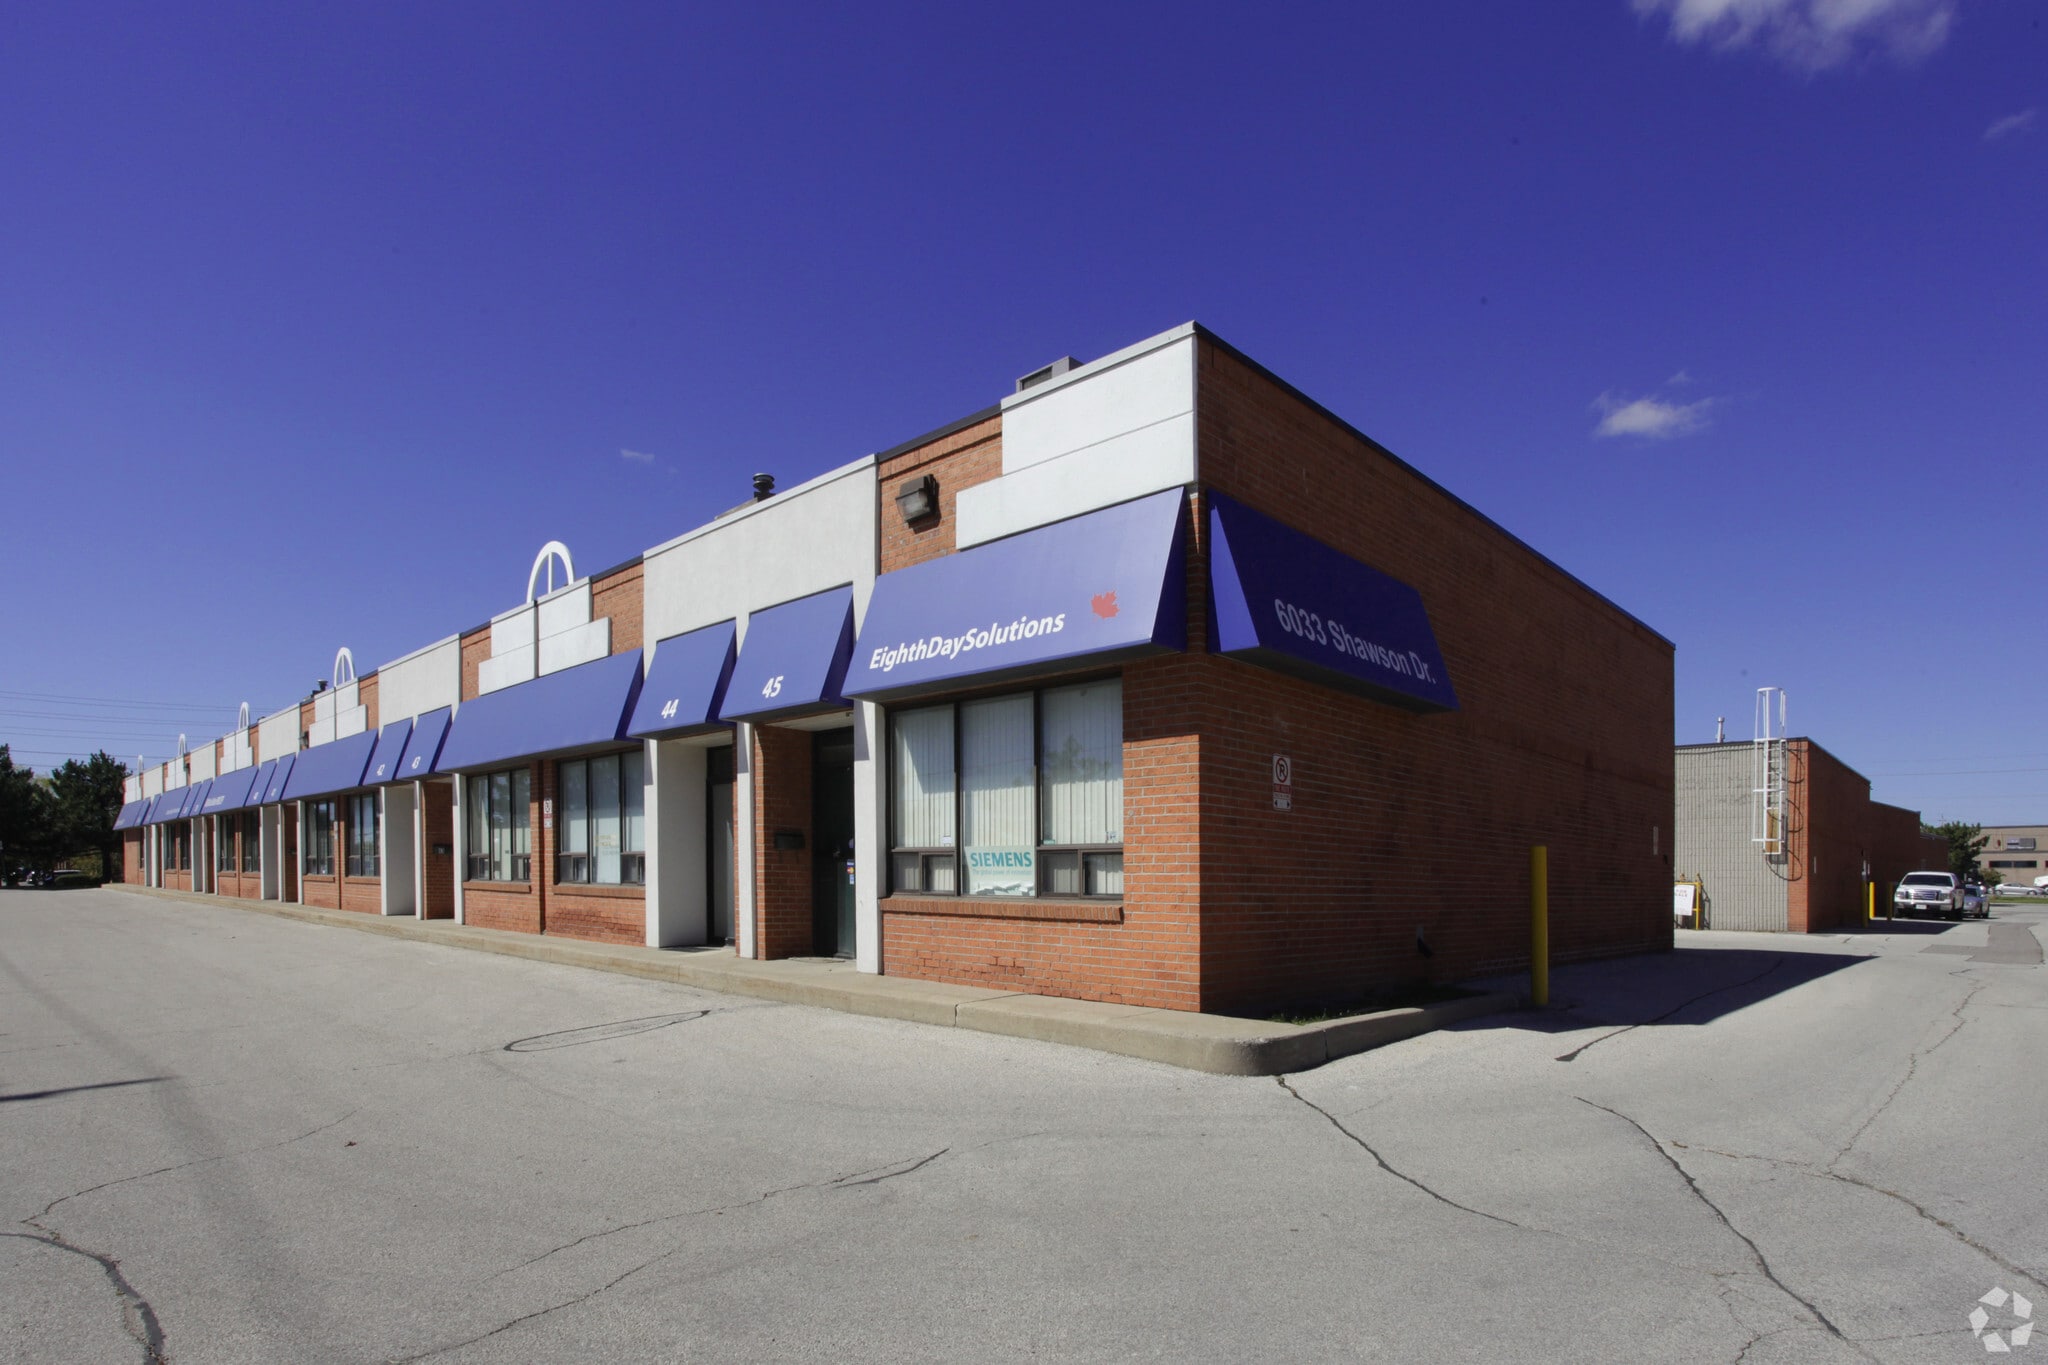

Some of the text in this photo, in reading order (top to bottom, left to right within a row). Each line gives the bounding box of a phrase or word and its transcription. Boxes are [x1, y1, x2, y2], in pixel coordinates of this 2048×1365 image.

[869, 613, 1066, 672] EighthDaySolutions
[1275, 599, 1436, 684] 6033 Shawson Dr.
[762, 675, 784, 698] 45
[661, 699, 680, 719] 44
[970, 851, 1033, 867] SIEMENS
